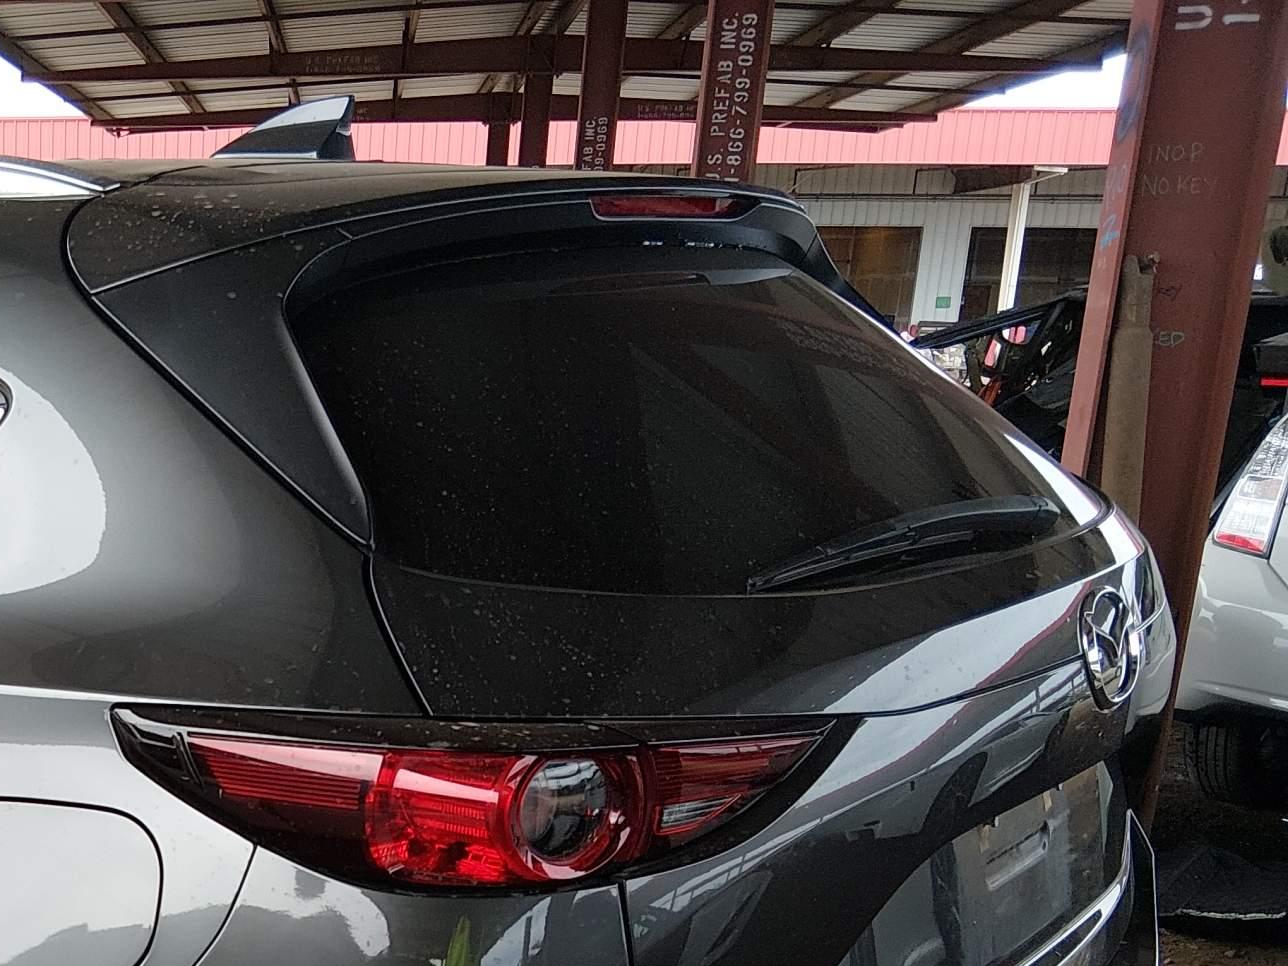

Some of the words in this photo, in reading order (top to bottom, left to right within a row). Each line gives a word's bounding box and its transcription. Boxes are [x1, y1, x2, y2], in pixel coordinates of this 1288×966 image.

[720, 12, 738, 48] INC.
[710, 60, 733, 136] PREFAB
[724, 13, 758, 182] 1-866-799-0969
[584, 117, 596, 140] INC.
[1141, 174, 1169, 196] NO
